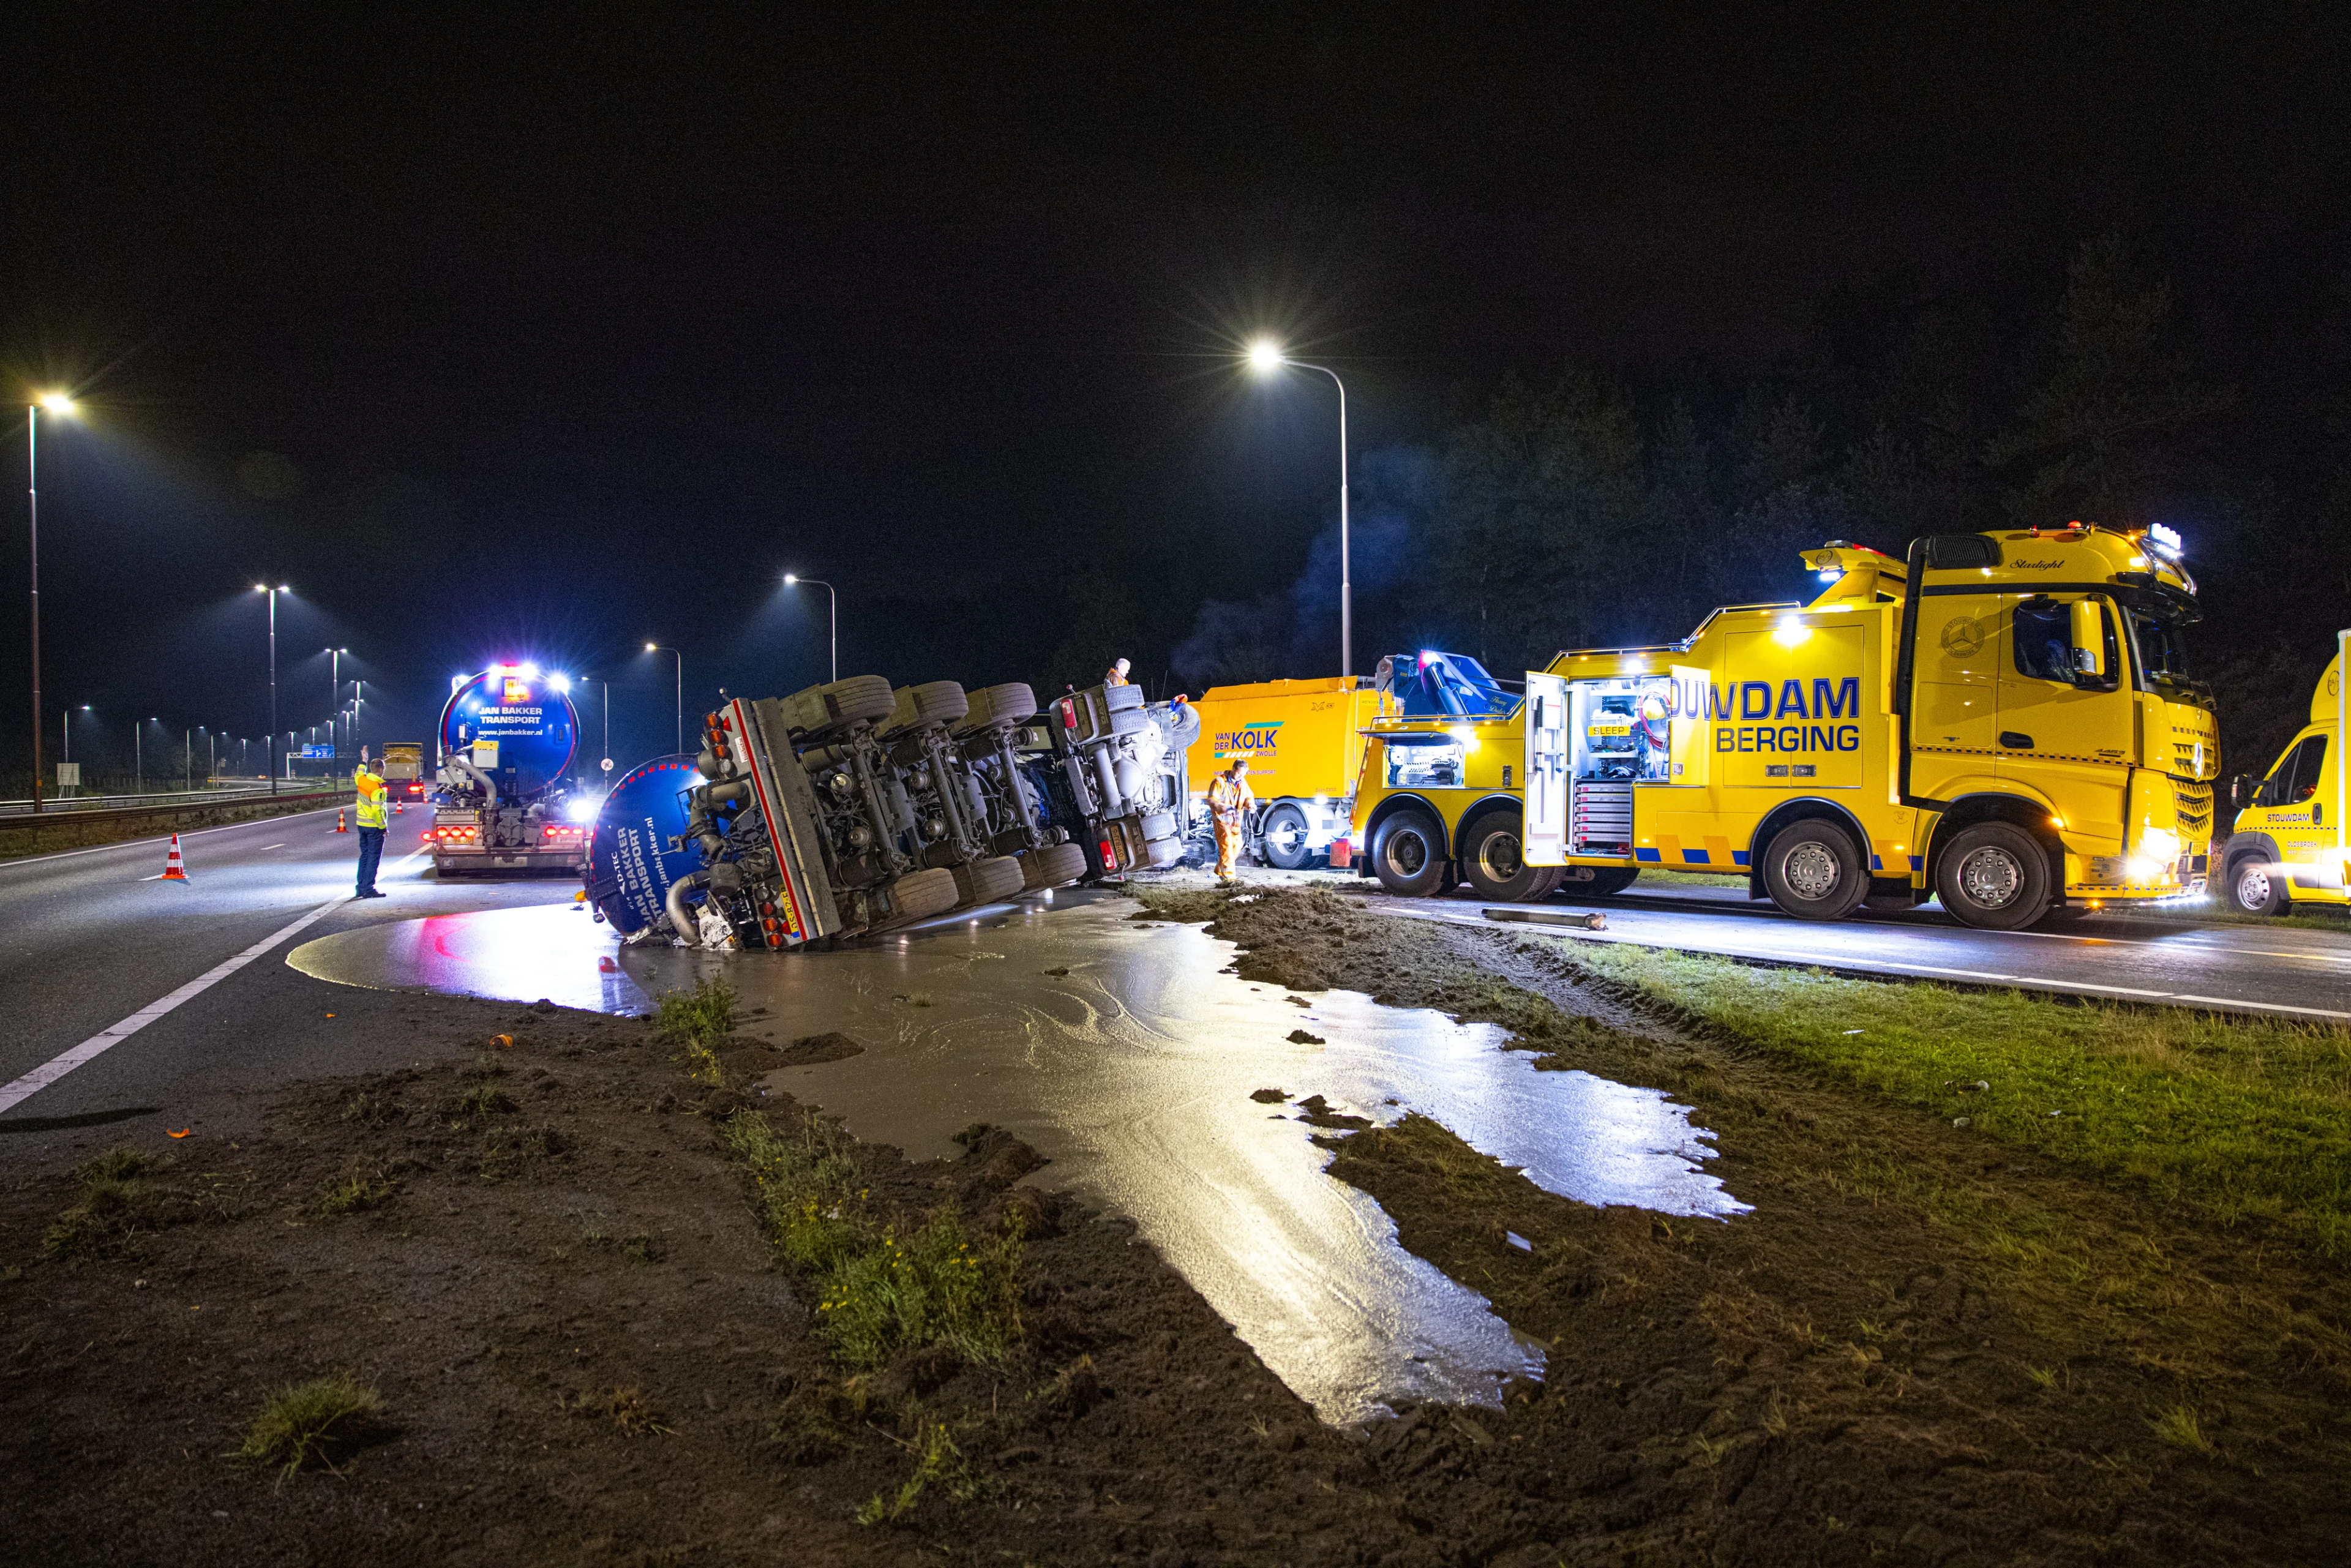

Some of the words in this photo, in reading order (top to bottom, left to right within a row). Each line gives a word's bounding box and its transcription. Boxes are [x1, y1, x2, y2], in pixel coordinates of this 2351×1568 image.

[2009, 559, 2065, 571] Starlight
[1231, 729, 1278, 749] KOLK
[1594, 726, 1624, 735] SLEEP
[1716, 725, 1859, 752] BERGING
[1133, 827, 1144, 855] DAF
[611, 851, 624, 882] D-TEC
[617, 827, 639, 891] BAKKER
[628, 828, 662, 918] TRANSPORT
[634, 894, 651, 922] JAN
